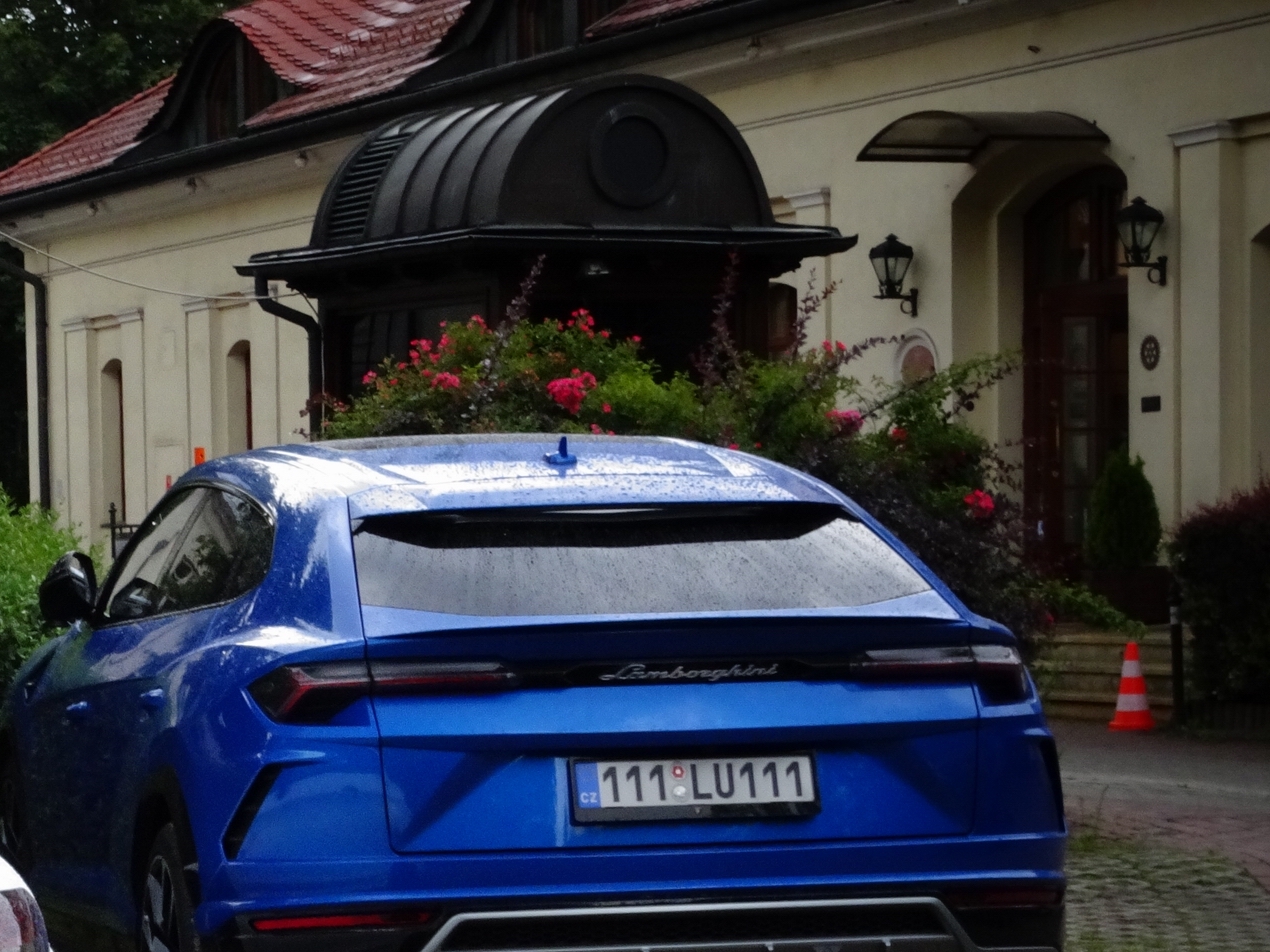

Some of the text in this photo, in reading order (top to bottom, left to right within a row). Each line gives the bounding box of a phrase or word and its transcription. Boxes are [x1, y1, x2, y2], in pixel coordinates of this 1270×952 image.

[599, 663, 779, 682] Lamborghini
[602, 761, 803, 802] 111 LU111
[580, 791, 598, 804] CZ
